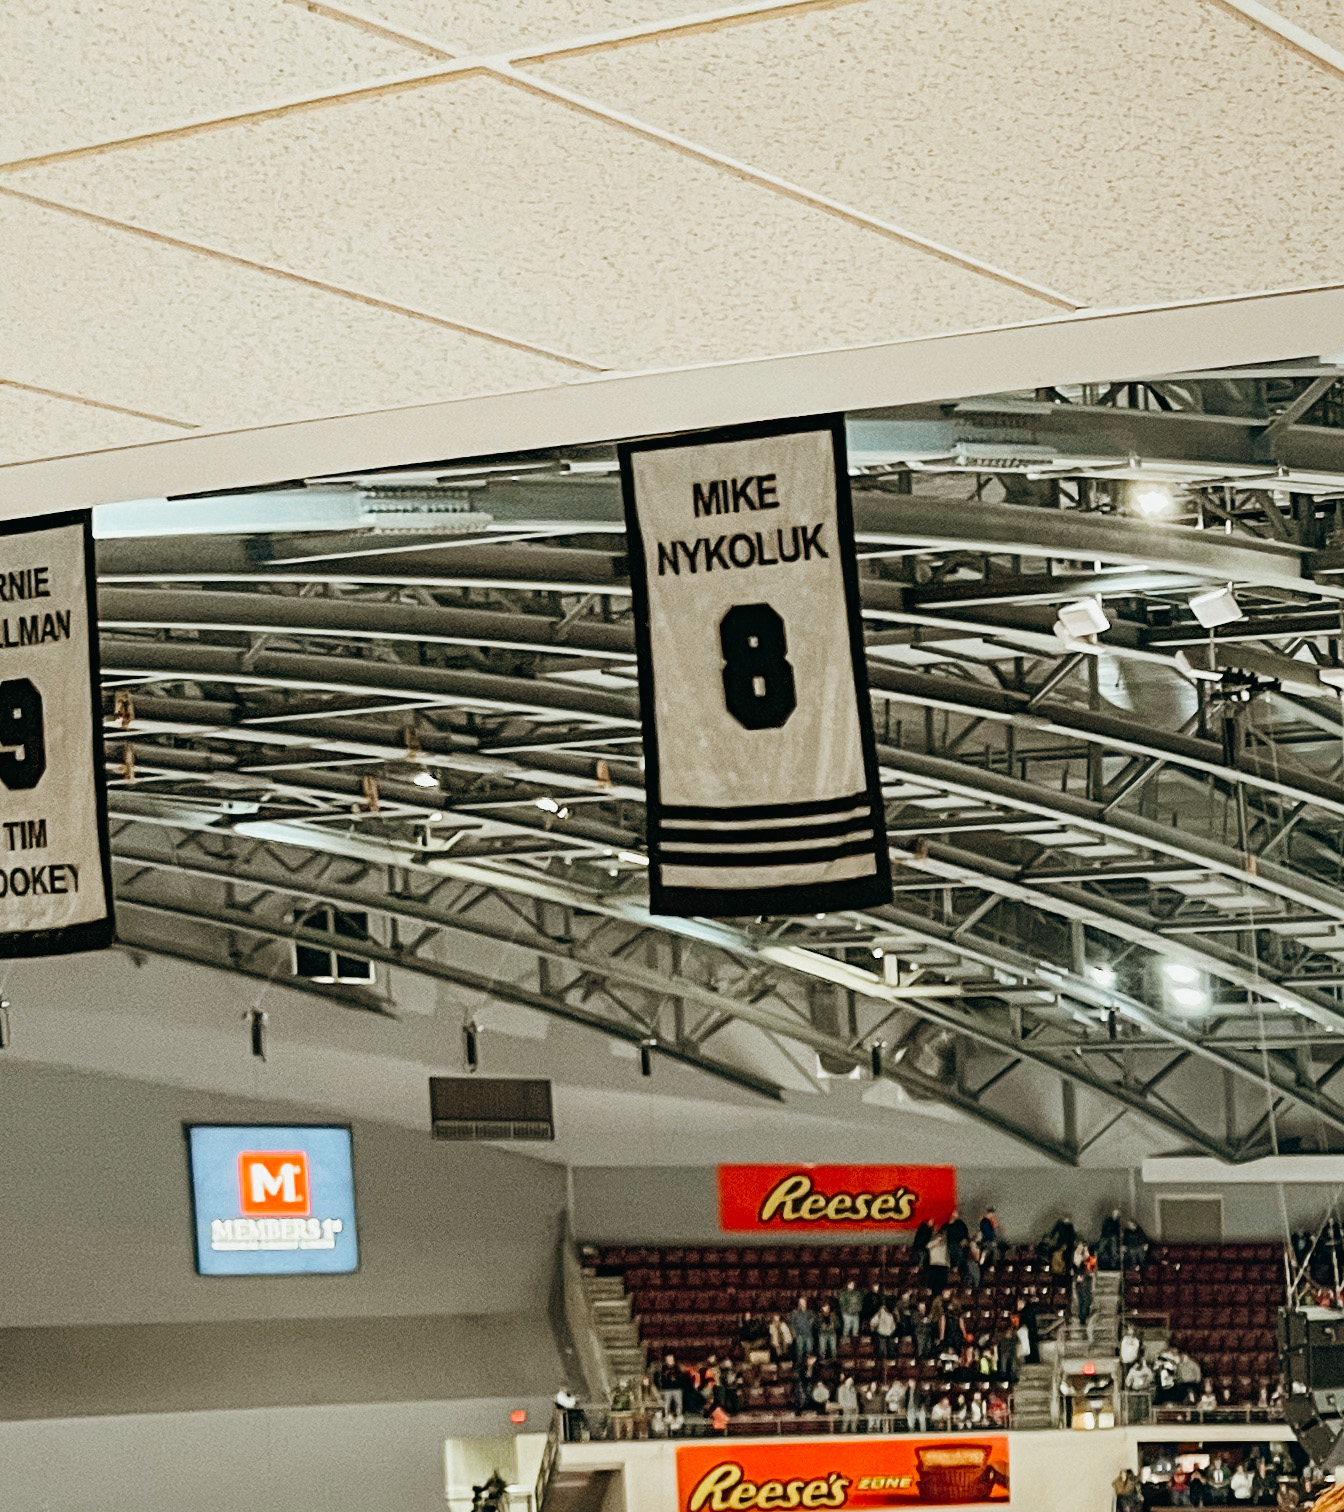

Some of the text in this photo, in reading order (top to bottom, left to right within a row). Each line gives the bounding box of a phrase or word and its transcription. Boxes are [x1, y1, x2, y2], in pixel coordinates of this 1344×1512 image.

[692, 474, 780, 518] MIKE
[658, 523, 829, 576] NYKOLUK
[0, 610, 71, 648] LMAN
[719, 602, 797, 731] 8
[3, 819, 47, 851] TIM
[760, 1174, 917, 1221] Reese's
[689, 1462, 913, 1512] Reese's ZONE
